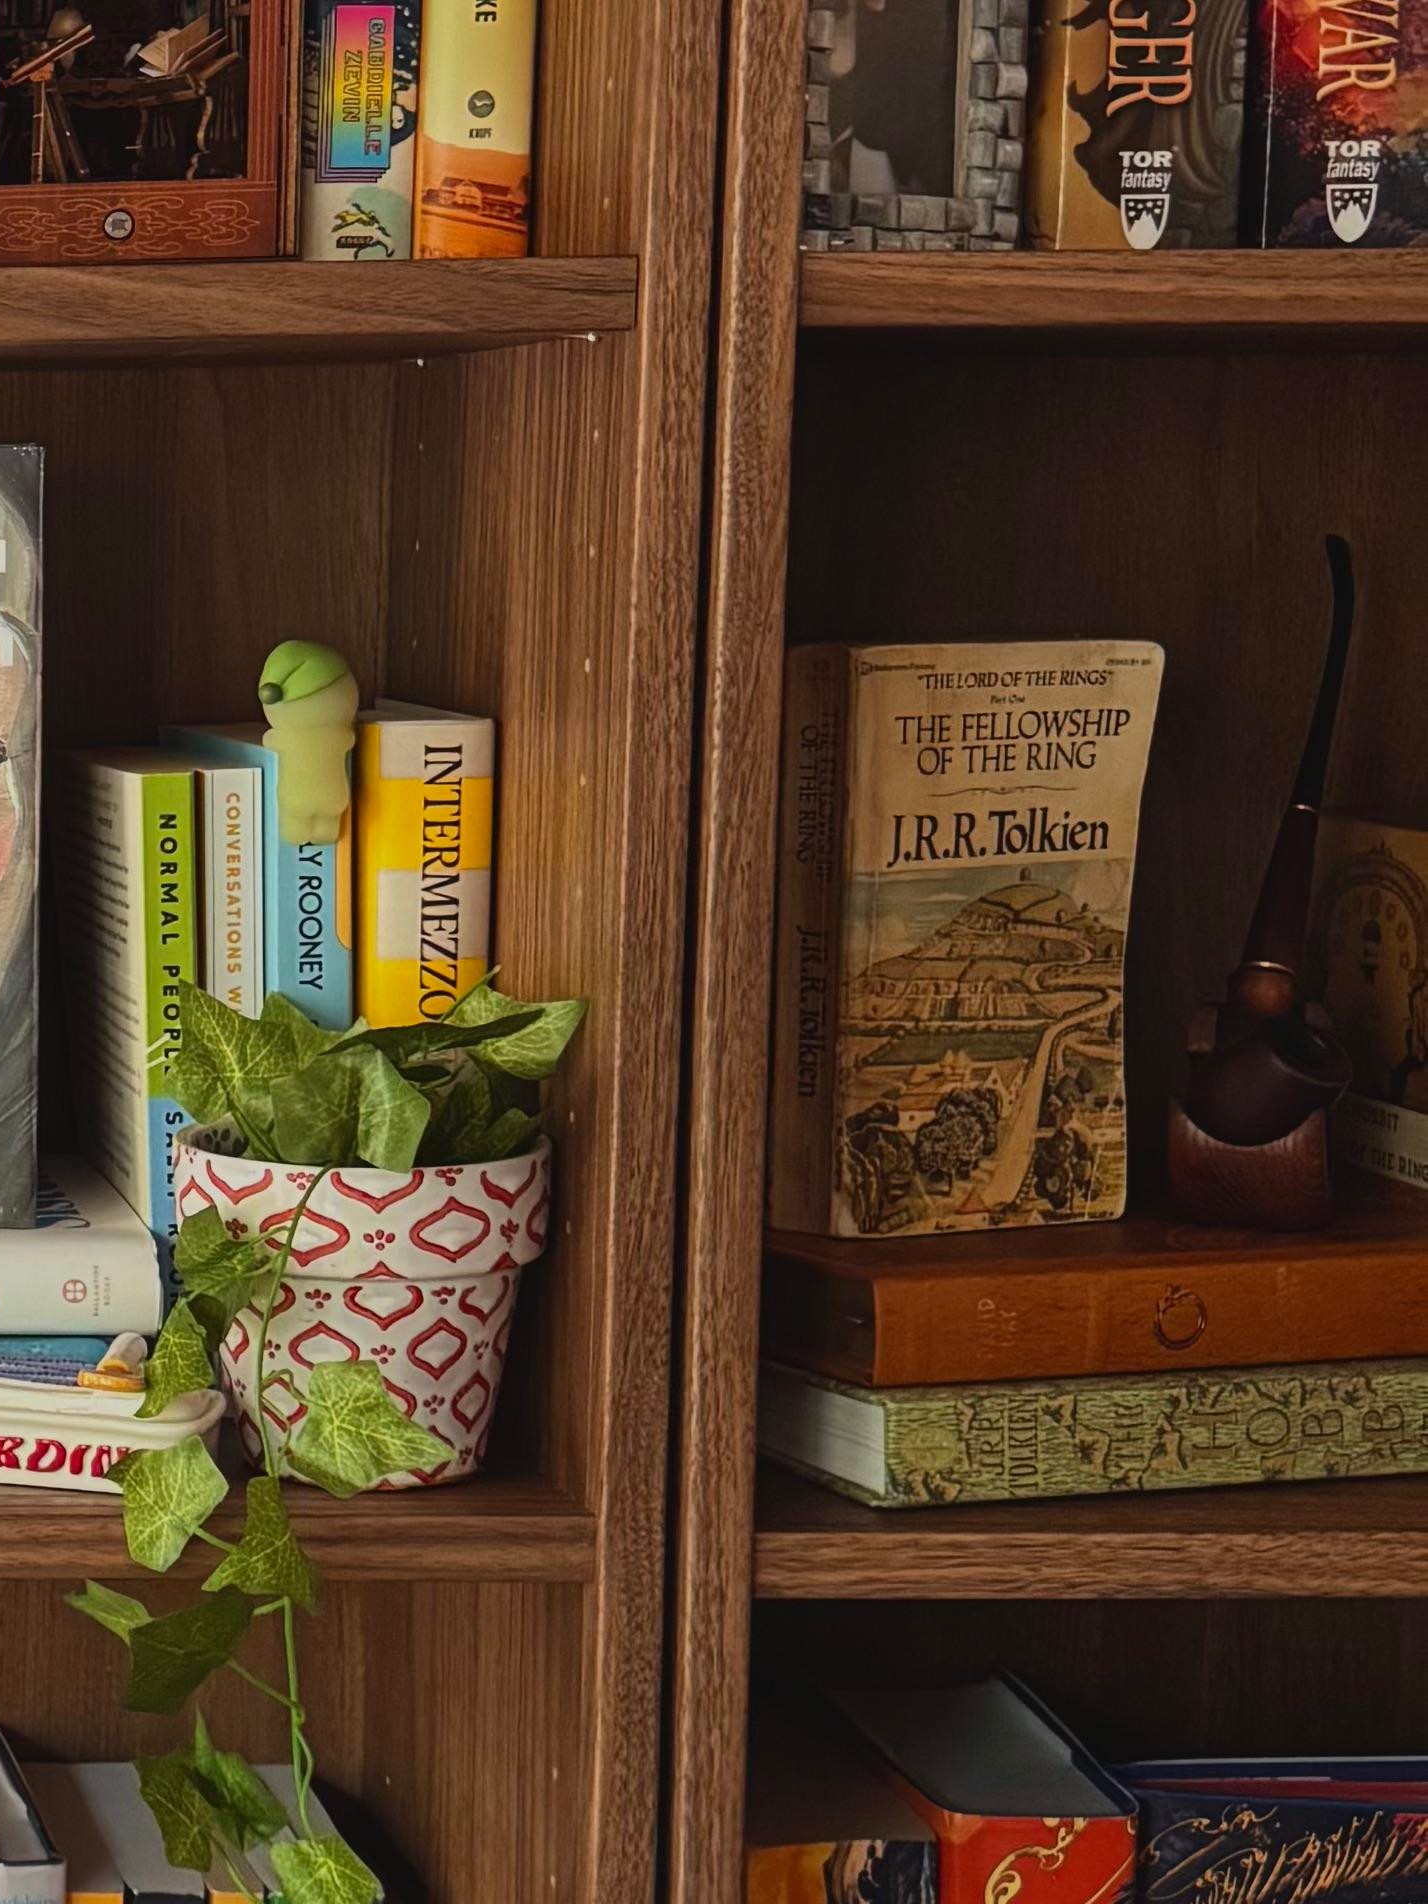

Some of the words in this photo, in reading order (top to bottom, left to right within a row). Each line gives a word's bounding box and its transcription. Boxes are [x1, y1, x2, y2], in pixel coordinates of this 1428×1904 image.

[895, 715, 951, 744] THE
[961, 709, 1131, 742] FELLOWSHIP
[917, 747, 952, 775] OF
[962, 744, 1016, 773] THE
[1027, 741, 1097, 771] RING
[887, 812, 986, 869] J.R.R.
[988, 807, 1110, 856] Tolkien
[418, 742, 464, 1020] INTERMEZZO
